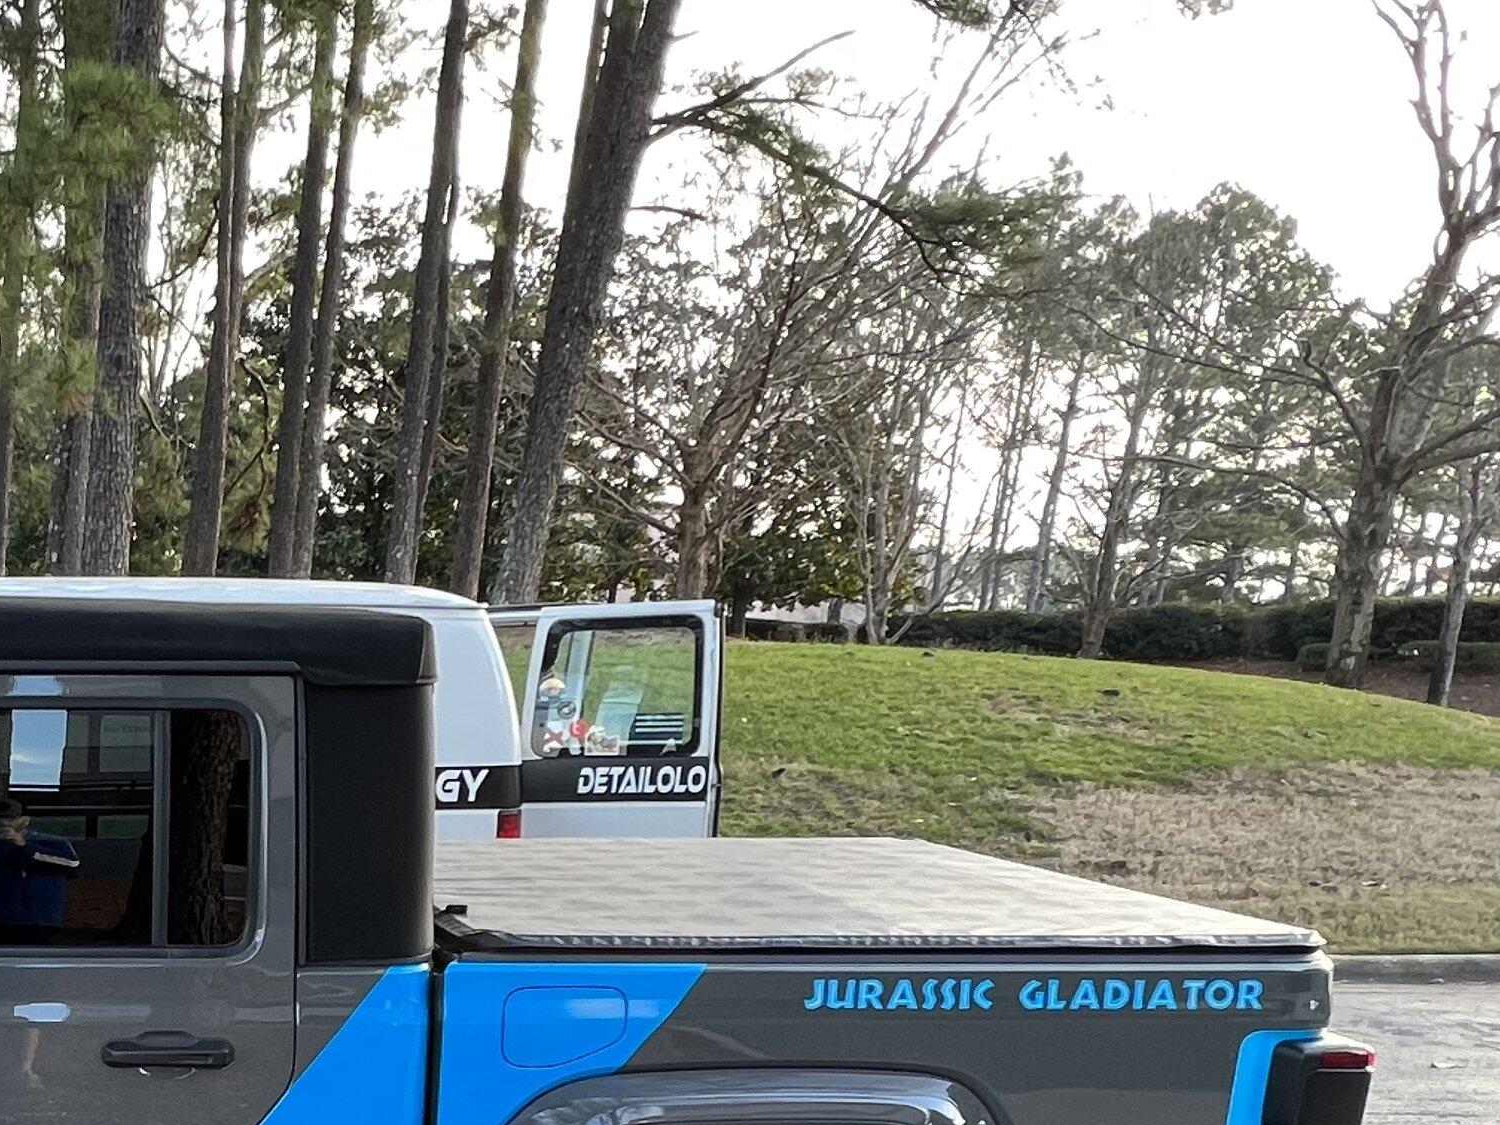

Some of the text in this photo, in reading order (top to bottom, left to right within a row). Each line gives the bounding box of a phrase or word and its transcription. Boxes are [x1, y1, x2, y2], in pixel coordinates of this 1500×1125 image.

[577, 765, 707, 795] DETAILOLO
[803, 978, 1264, 1011] JURASSIC GLADIATOR
